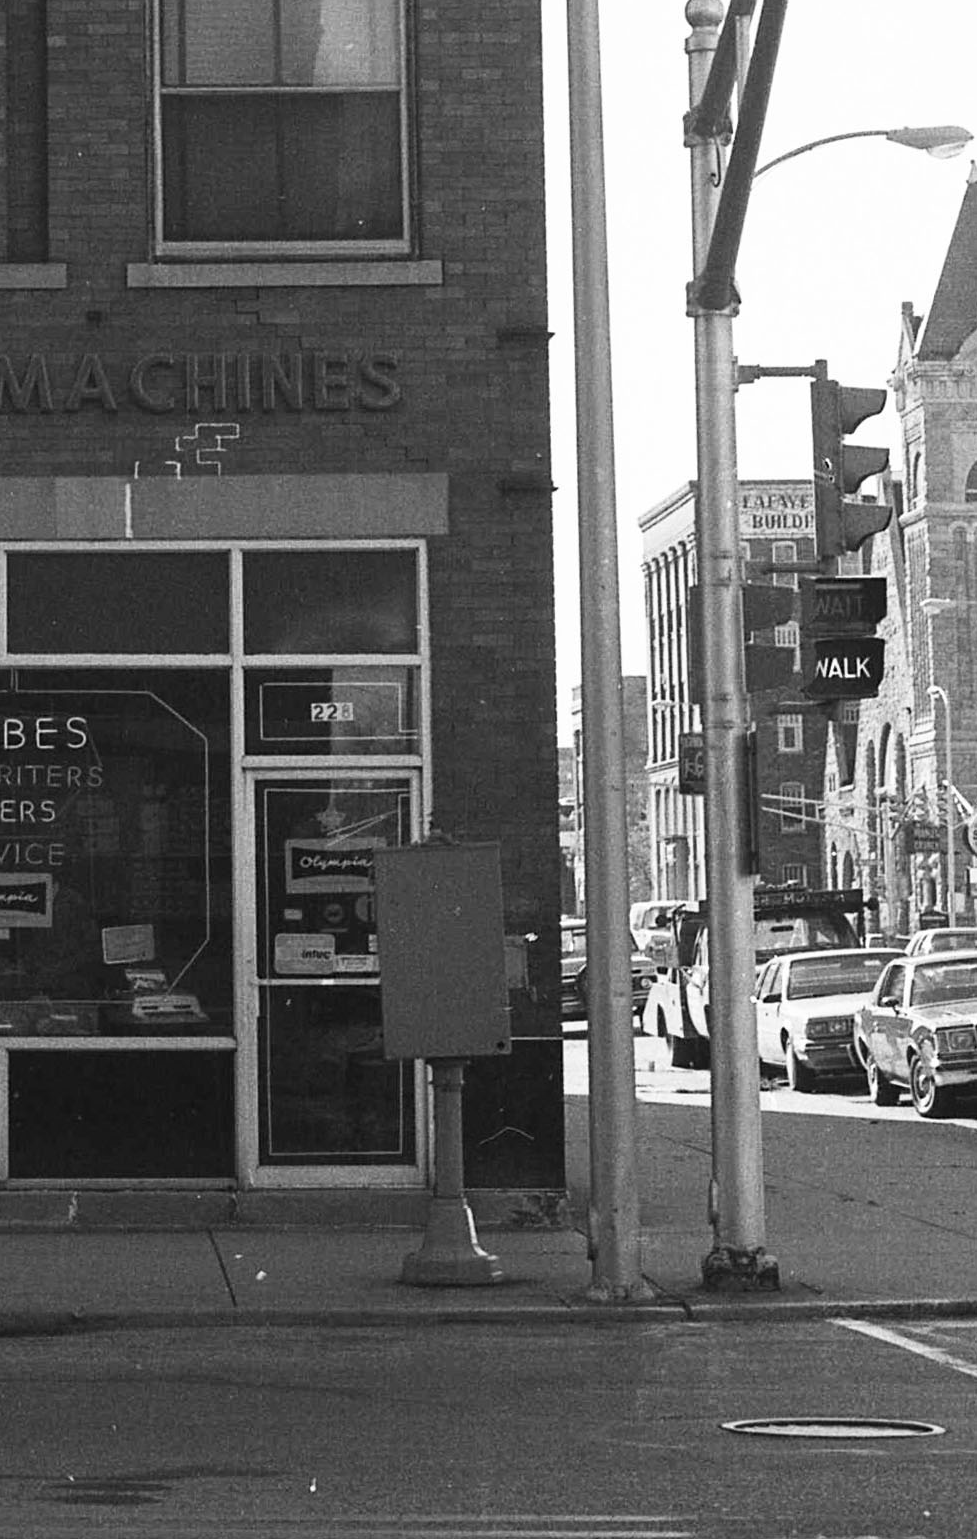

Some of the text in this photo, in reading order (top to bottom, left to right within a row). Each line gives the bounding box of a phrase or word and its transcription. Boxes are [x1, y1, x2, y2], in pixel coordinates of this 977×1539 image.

[742, 494, 814, 510] LAFAYE
[814, 656, 871, 679] WALK
[312, 704, 352, 722] 228
[300, 855, 373, 870] Olympia
